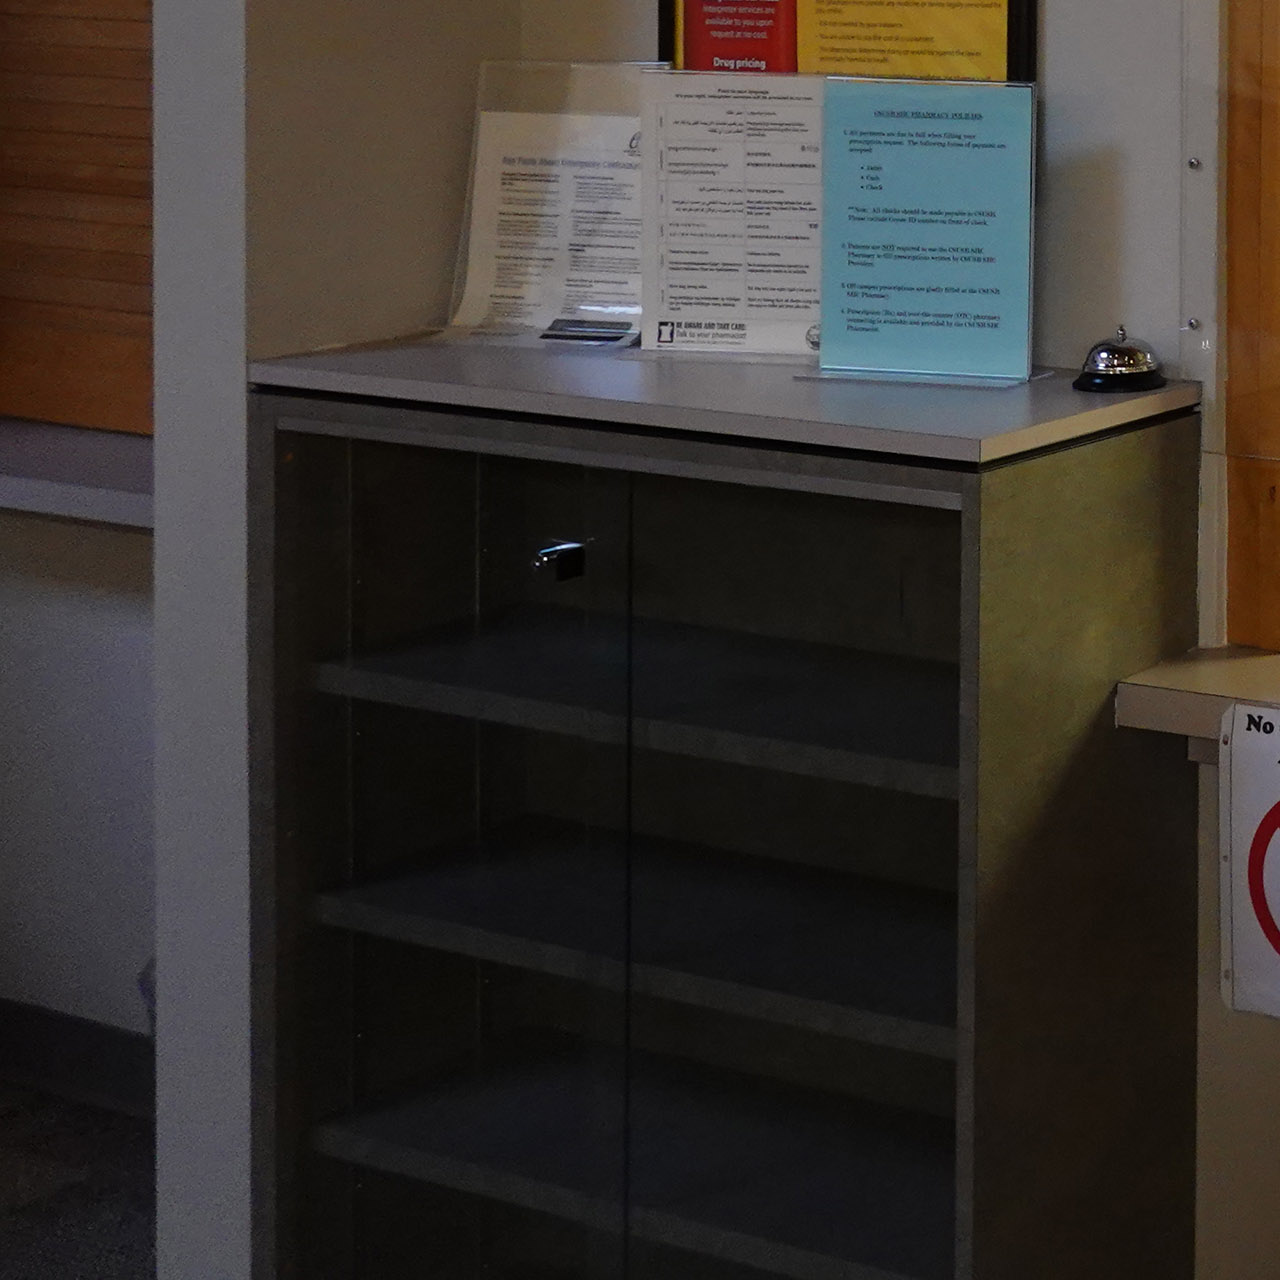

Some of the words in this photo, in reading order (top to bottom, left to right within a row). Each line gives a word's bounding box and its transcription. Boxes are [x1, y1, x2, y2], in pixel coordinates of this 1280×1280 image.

[713, 56, 734, 69] Drug
[735, 57, 766, 70] pricing
[1246, 714, 1275, 735] No
